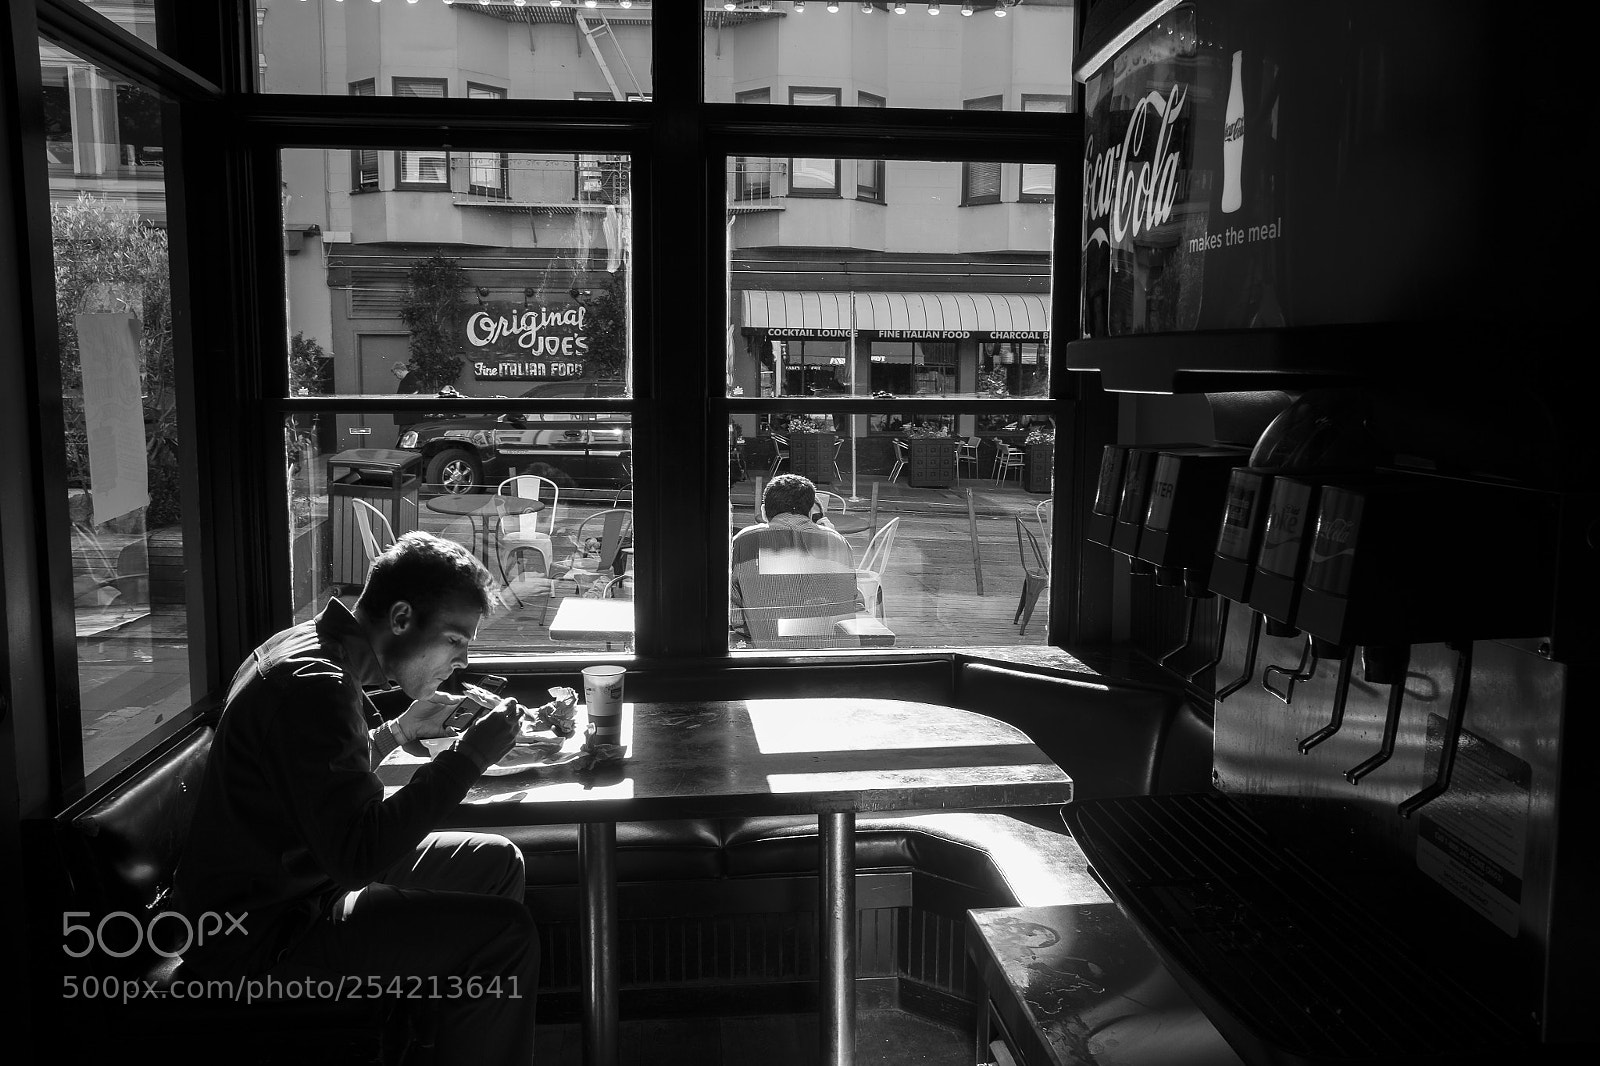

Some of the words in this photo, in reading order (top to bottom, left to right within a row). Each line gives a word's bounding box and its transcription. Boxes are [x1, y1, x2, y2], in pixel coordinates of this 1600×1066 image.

[1189, 231, 1222, 253] makes
[1226, 226, 1245, 247] the
[1248, 217, 1281, 243] meal
[466, 306, 587, 349] Original
[767, 328, 815, 337] COCKTAIL
[817, 329, 859, 338] LOUNGE
[878, 330, 900, 338] FINE
[902, 331, 941, 339] ITALIAN
[942, 331, 971, 339] FOOD
[990, 331, 1040, 340] CHARCOAL
[532, 333, 589, 356] JOE'S
[474, 362, 498, 376] Fine
[498, 362, 546, 377] ITALIAN
